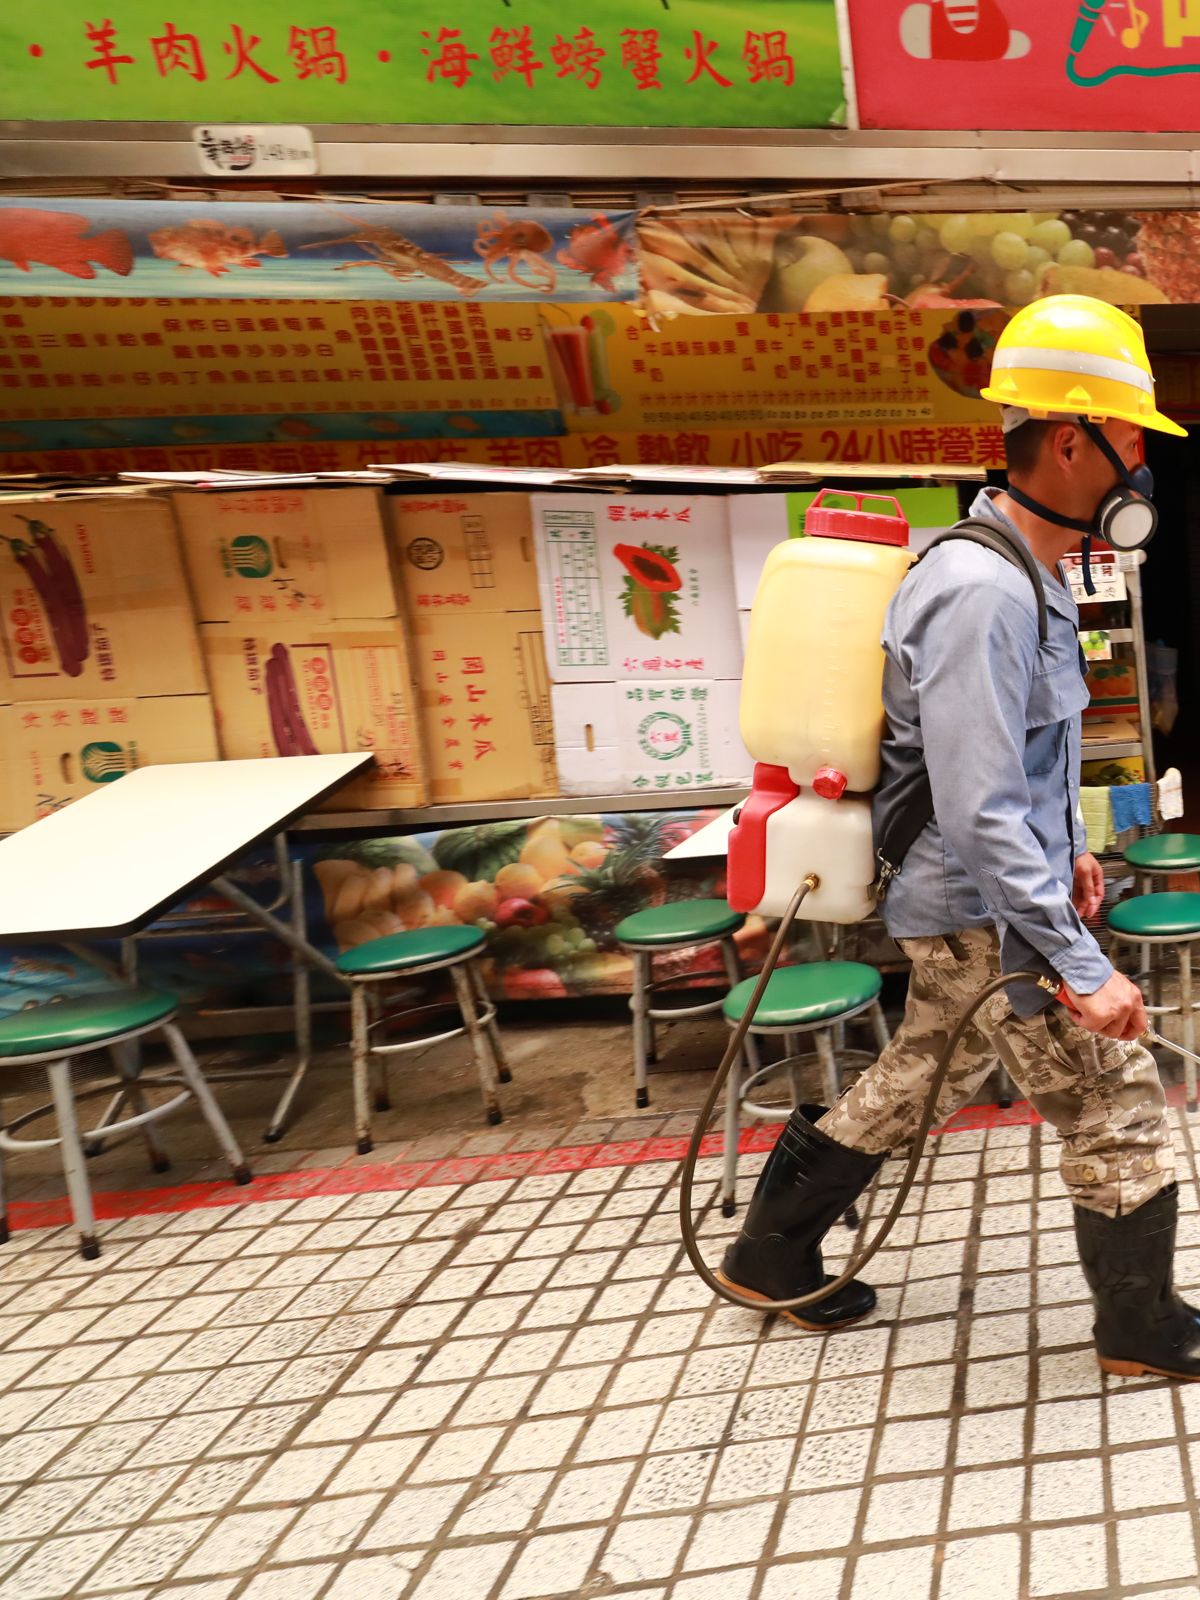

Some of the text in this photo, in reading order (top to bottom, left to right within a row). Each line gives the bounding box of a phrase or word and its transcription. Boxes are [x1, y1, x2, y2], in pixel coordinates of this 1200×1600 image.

[83, 20, 797, 92] 羊肉火鍋 海鮮螃蟹火鍋
[731, 430, 804, 464] 小吃
[461, 656, 497, 761] 岡山木瓜
